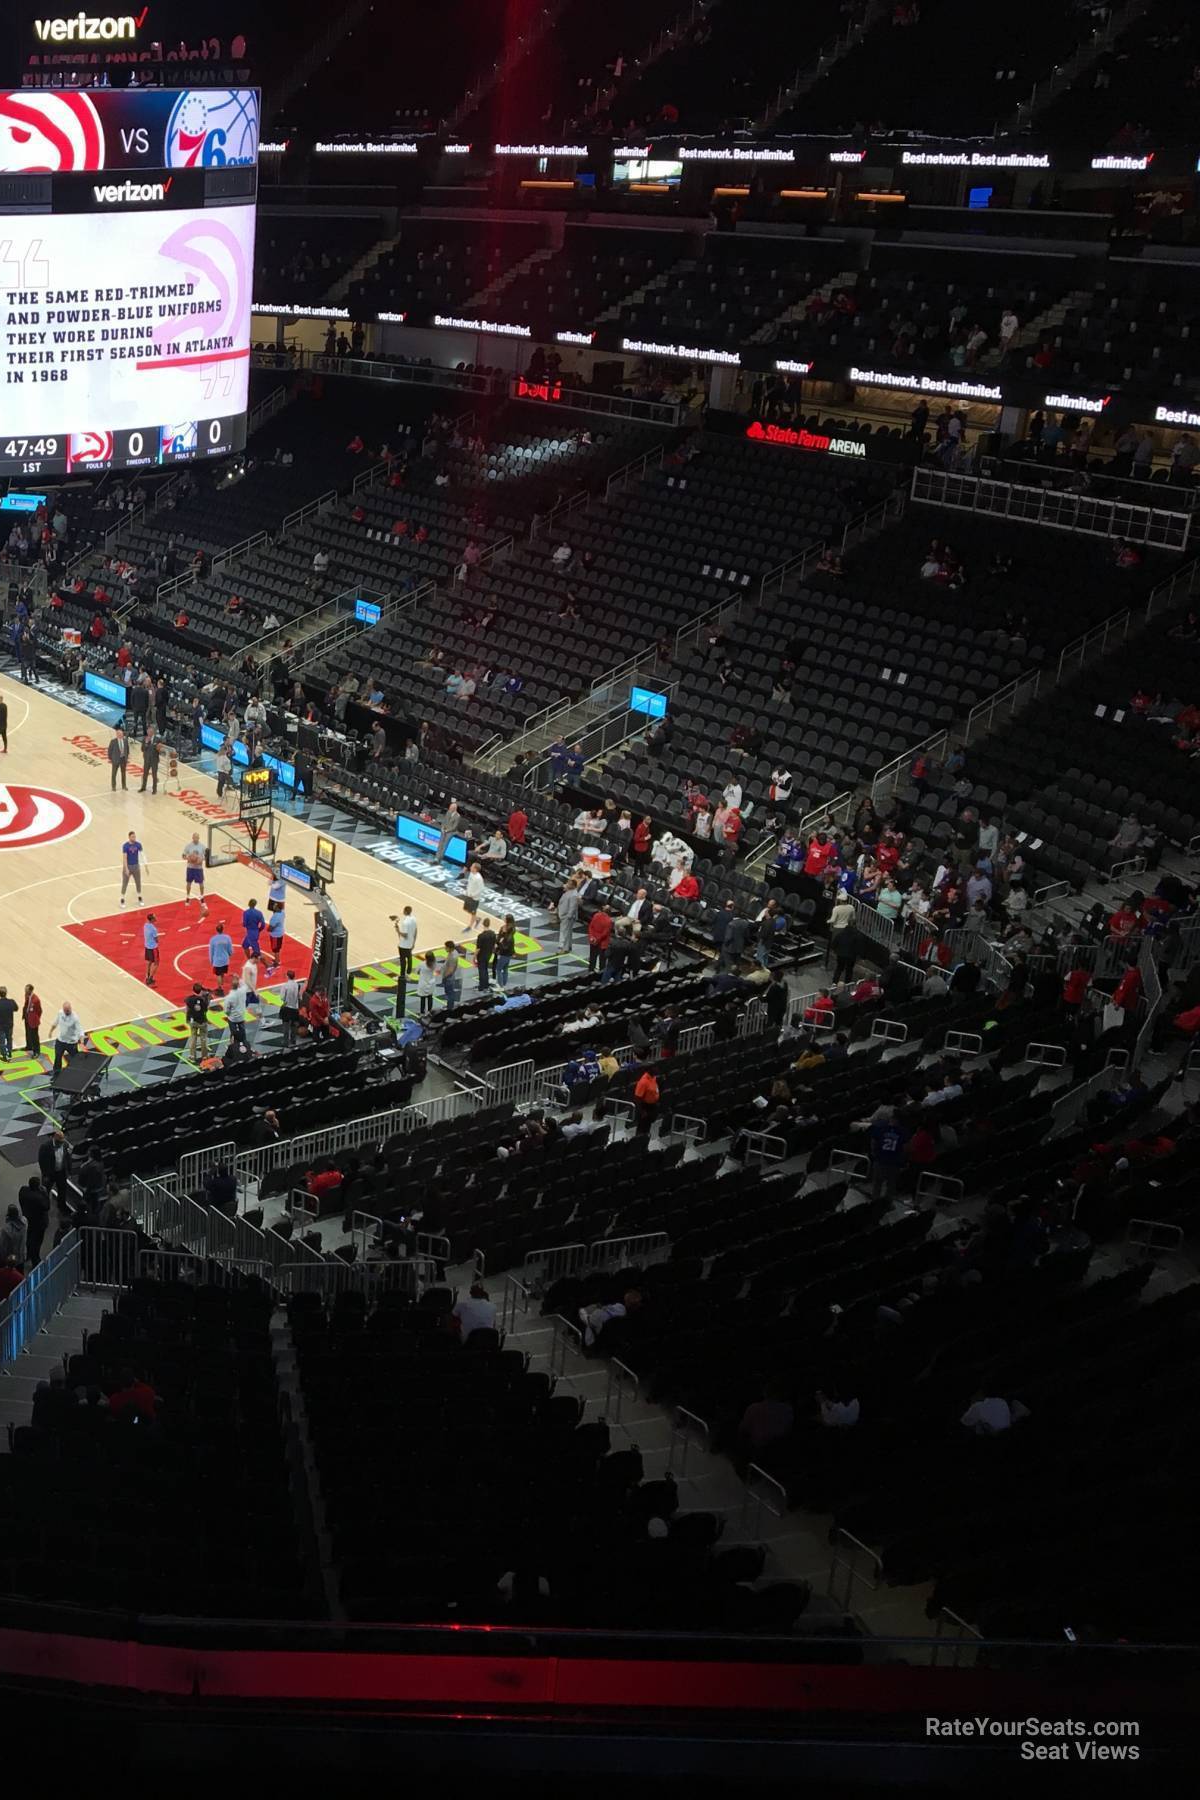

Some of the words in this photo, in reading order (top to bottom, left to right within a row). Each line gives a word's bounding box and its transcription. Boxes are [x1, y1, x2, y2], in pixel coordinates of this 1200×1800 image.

[35, 12, 136, 40] verizon
[120, 128, 150, 154] VS
[259, 142, 286, 151] limited
[316, 143, 333, 152] Best
[333, 142, 366, 152] network.
[366, 143, 384, 152] Best
[384, 143, 418, 152] unlimited.
[445, 144, 470, 153] verizon
[495, 144, 513, 154] Best
[513, 145, 538, 154] network.
[539, 145, 556, 155] Best
[556, 146, 589, 156] unlimited.
[614, 147, 649, 157] unlimited
[679, 148, 697, 158] Best
[697, 148, 733, 159] network.
[733, 149, 753, 160] Best
[753, 150, 795, 160] unlimited.
[830, 151, 862, 162] verizon
[902, 152, 926, 164] Best
[926, 153, 971, 165] network.
[971, 153, 996, 165] Best
[997, 154, 1050, 168] unlimited.
[1091, 156, 1147, 170] unlimited
[93, 180, 164, 202] verizon
[6, 292, 39, 305] THE
[45, 289, 89, 304] SAME
[95, 283, 194, 302] RED-TRIMMED
[6, 311, 40, 325] AND
[46, 305, 153, 325] POWDER-BLUE
[159, 299, 222, 318] UNIFORMS
[251, 303, 261, 312] st
[261, 304, 292, 313] network.
[293, 304, 311, 315] Best
[311, 306, 350, 318] unlimited.
[378, 311, 404, 322] verizon
[434, 315, 453, 326] Best
[453, 317, 481, 330] network.
[481, 320, 498, 332] Best
[498, 322, 531, 336] unlimited.
[6, 332, 46, 346] THEY
[53, 329, 95, 345] WORE
[101, 326, 153, 342] DURING
[557, 330, 592, 344] unlimited
[6, 350, 55, 365] THEIR
[60, 347, 105, 363] FIRST
[110, 344, 162, 361] SEASON
[166, 341, 180, 355] IN
[185, 335, 234, 354] ATLANTA
[622, 338, 642, 351] Best
[642, 341, 678, 355] network.
[679, 346, 699, 359] Best
[699, 348, 741, 364] unlimited.
[776, 359, 809, 373] verizon
[6, 371, 24, 383] IN
[31, 369, 68, 383] 1968
[850, 367, 875, 382] Best
[875, 370, 920, 388] network.
[921, 376, 947, 391] Best
[947, 380, 1002, 399] unlimited.
[1045, 394, 1103, 412] unlimited
[1155, 406, 1187, 424] Best
[209, 420, 221, 444] 0
[4, 438, 58, 457] 47:49
[128, 432, 144, 456] 0
[829, 438, 866, 456] ARENA
[22, 462, 42, 473] 1ST
